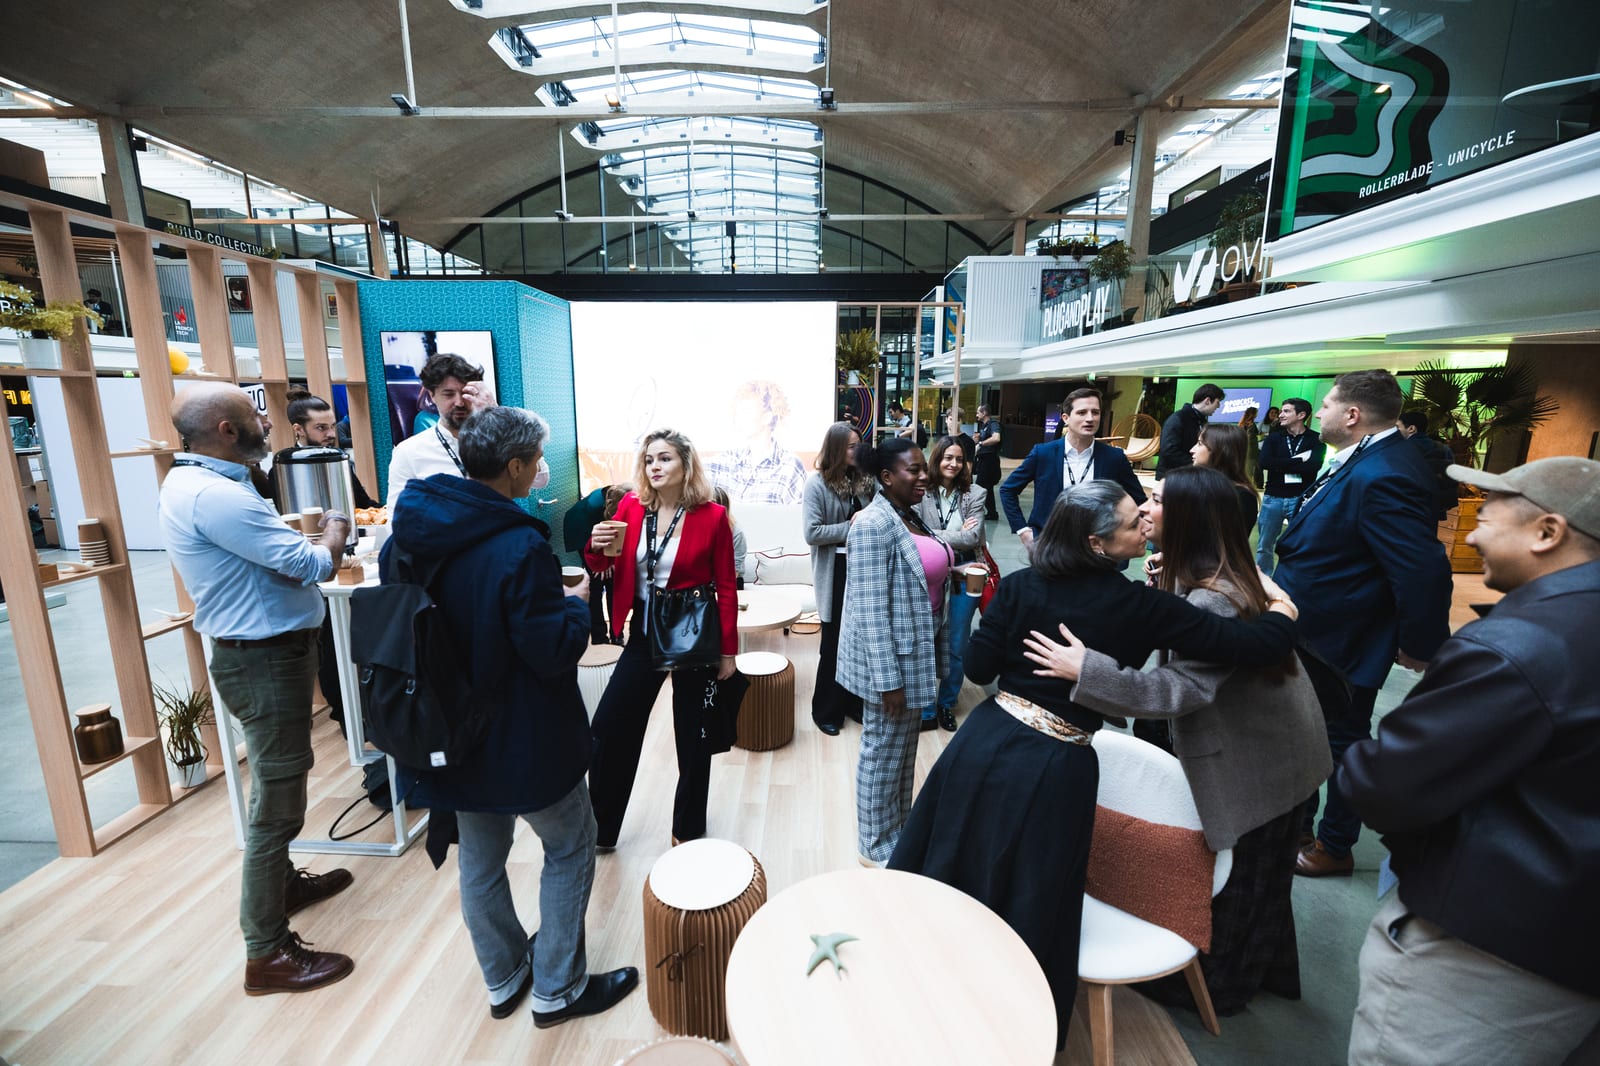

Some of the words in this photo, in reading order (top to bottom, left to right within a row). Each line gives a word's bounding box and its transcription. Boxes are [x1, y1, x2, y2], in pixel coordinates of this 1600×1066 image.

[1358, 161, 1434, 198] ROLLERBLADE
[1447, 130, 1516, 166] UNICYCLE
[207, 233, 265, 255] COLLECTIV
